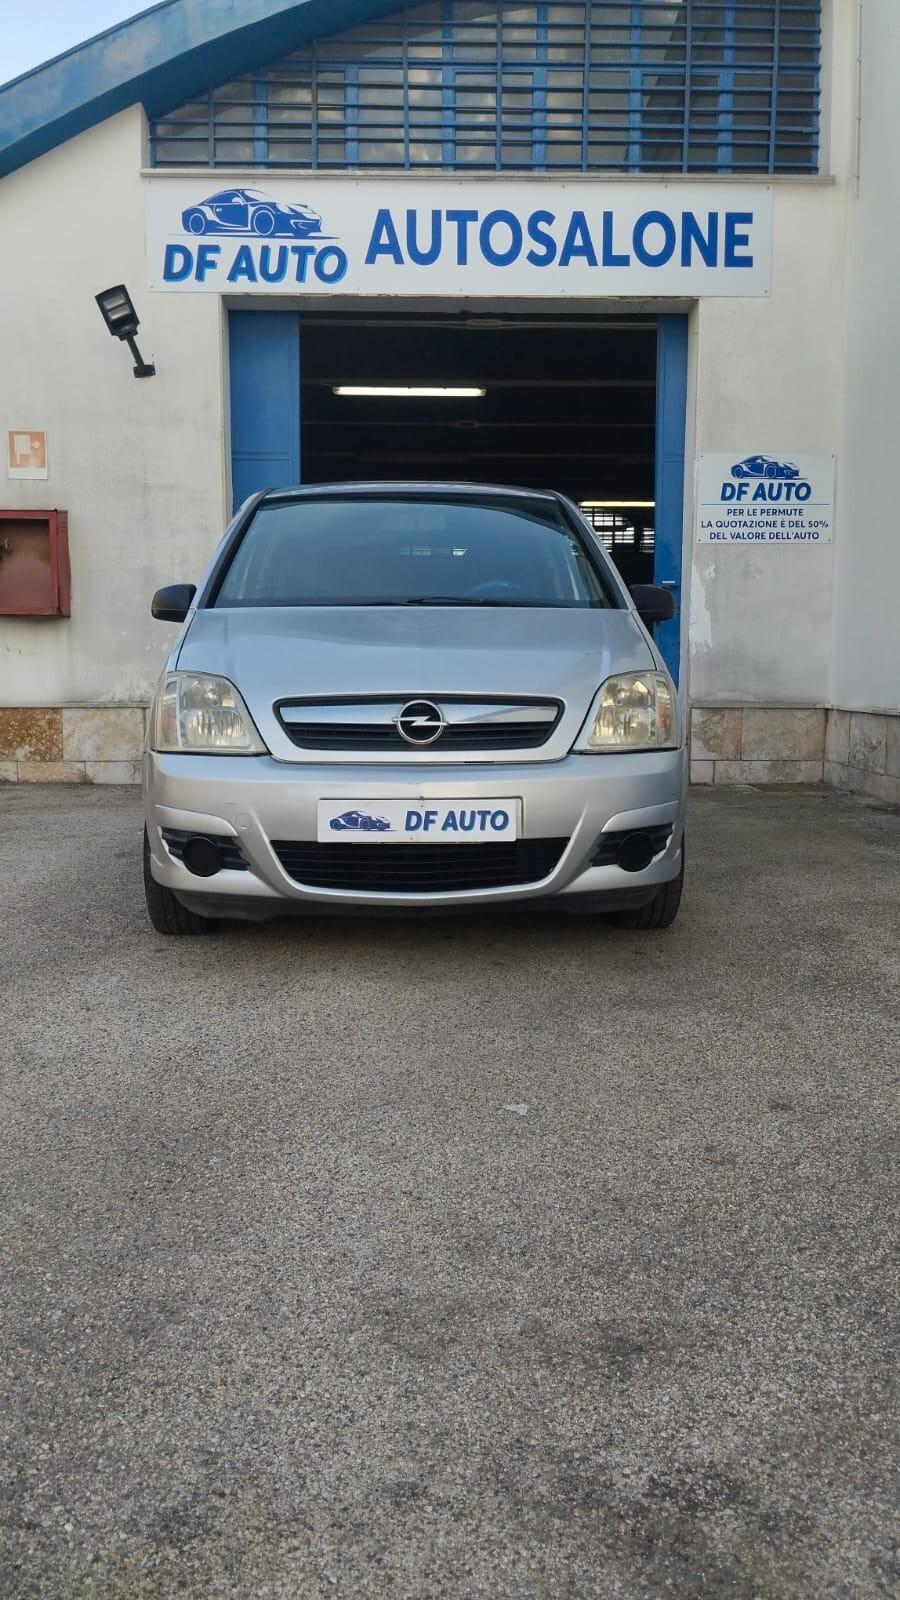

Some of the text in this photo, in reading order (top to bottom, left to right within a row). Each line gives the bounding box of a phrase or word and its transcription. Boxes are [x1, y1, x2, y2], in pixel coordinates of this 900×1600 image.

[364, 208, 754, 269] AUTOSALONE
[163, 243, 349, 284] DF AUTO
[720, 482, 812, 501] DF AUTO
[727, 508, 804, 517] PER LE PERMUTE
[701, 520, 713, 528] LA
[715, 520, 778, 528] QUOTAZIONE
[788, 520, 806, 528] DEL
[808, 520, 829, 528] 50%
[709, 531, 820, 540] DEL VALORE DELL'AUTO
[405, 810, 509, 831] DF AUTO
